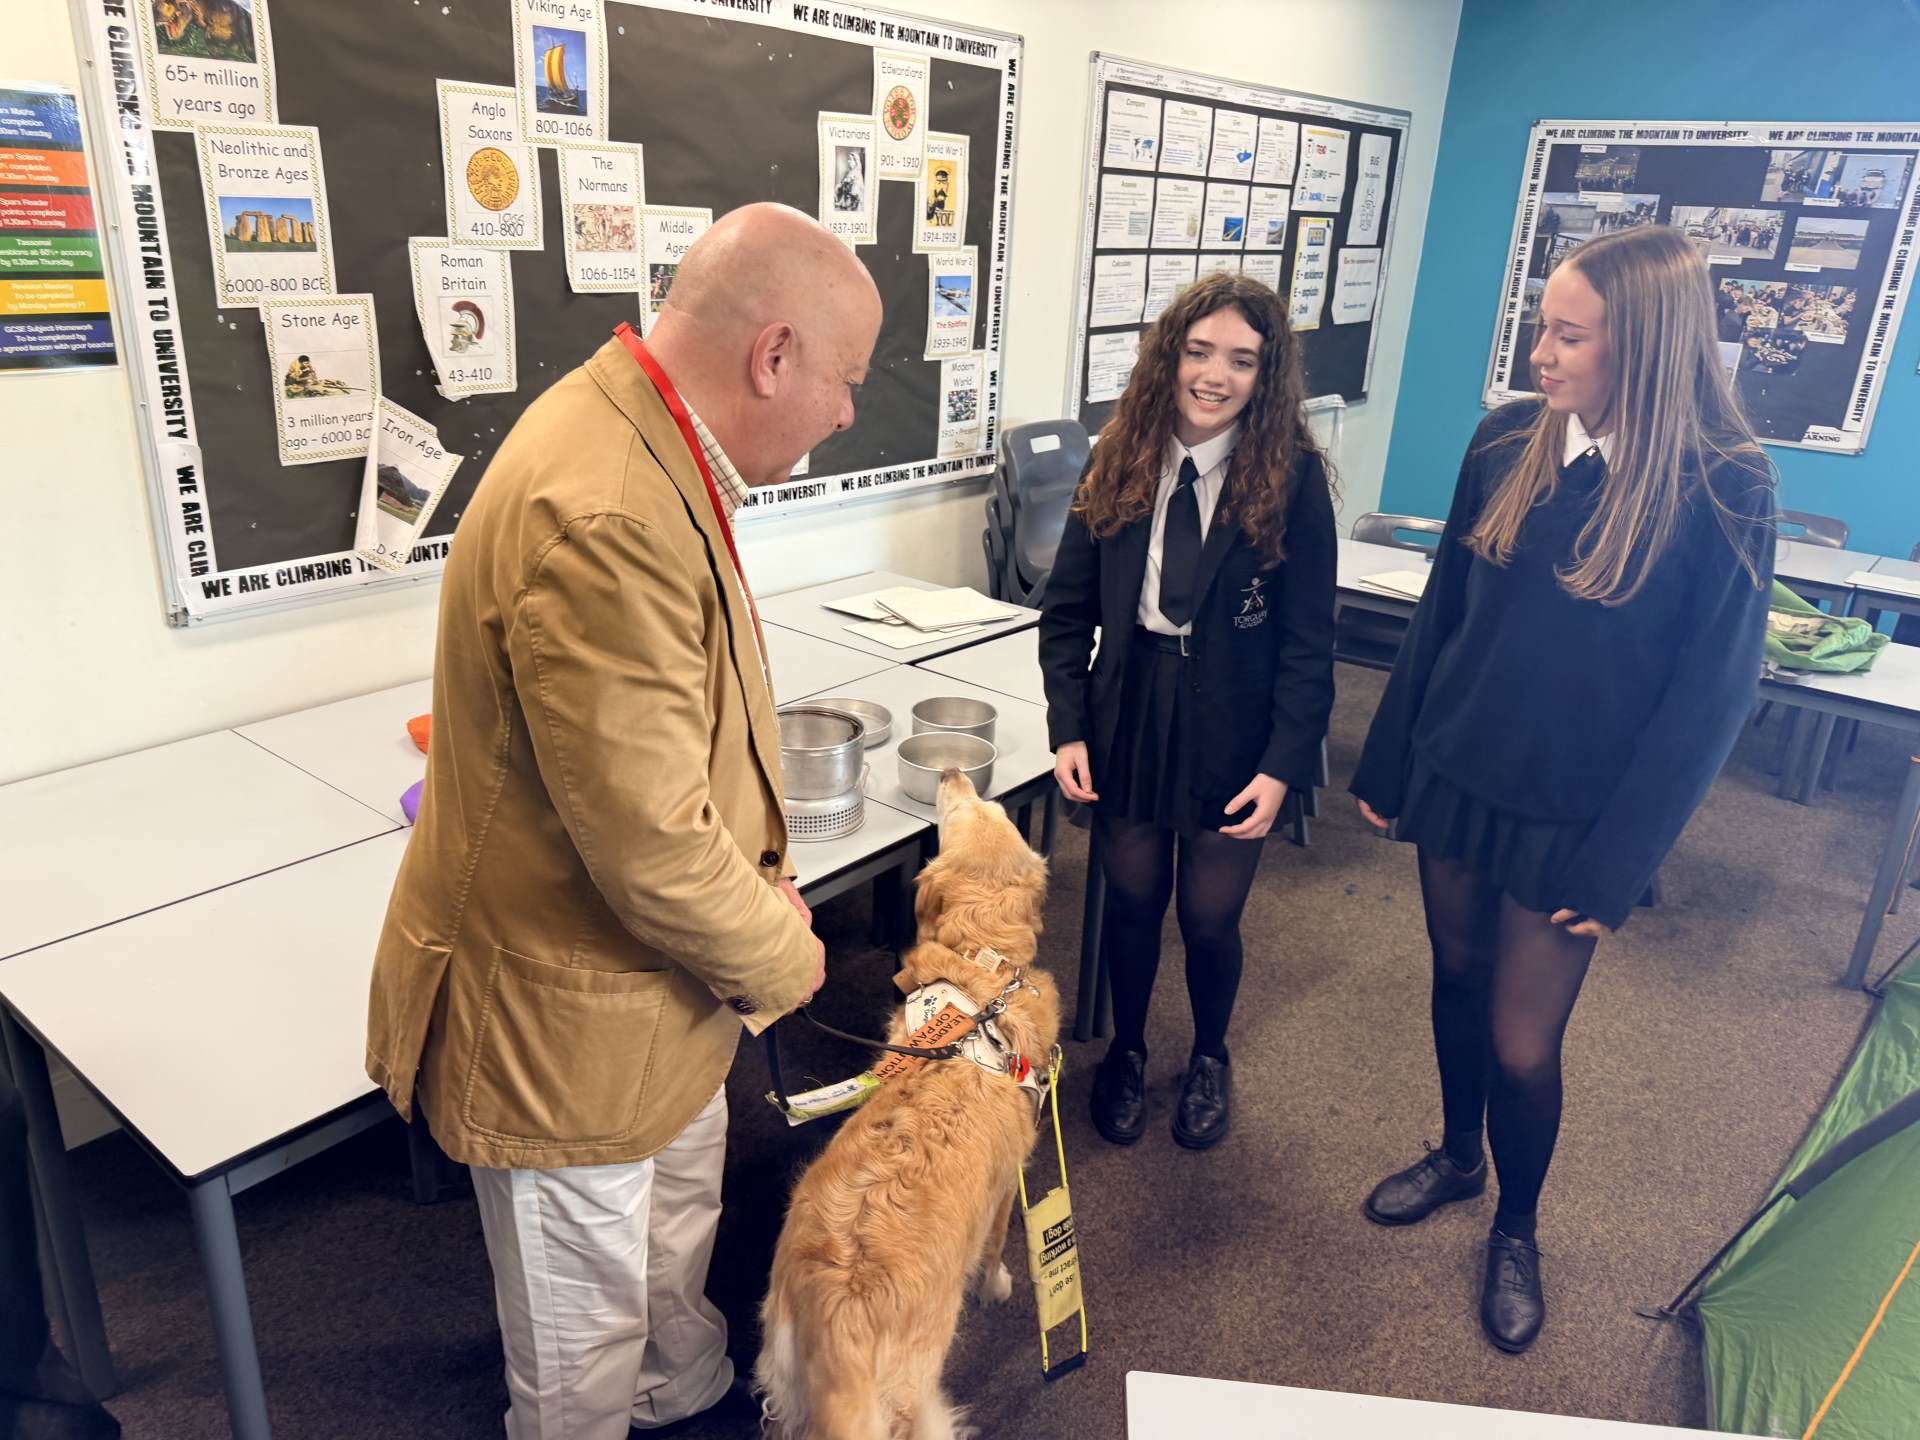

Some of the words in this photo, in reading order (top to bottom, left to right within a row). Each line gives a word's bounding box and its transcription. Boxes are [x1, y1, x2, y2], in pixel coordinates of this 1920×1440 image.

[527, 0, 566, 19] Viking
[569, 3, 593, 22] Age
[793, 3, 809, 22] WE
[812, 8, 830, 27] ARE
[832, 12, 876, 36] CLIMBING
[880, 21, 894, 40] THE
[897, 25, 940, 49] MOUNTAIN
[943, 34, 953, 50] TO
[955, 36, 998, 60] UNIVERSITY
[165, 64, 198, 82] 65+
[204, 68, 260, 89] million
[1008, 58, 1017, 78] WE
[1006, 84, 1016, 106] ARE
[172, 97, 222, 115] years
[227, 102, 256, 119] ago
[471, 101, 507, 121] Anglo
[468, 124, 513, 141] Saxons
[535, 119, 593, 137] 800-1066
[828, 126, 871, 140] Victorians
[1546, 128, 1558, 138] WE
[1560, 129, 1576, 139] ARE
[1578, 129, 1615, 139] CLIMBING
[1619, 129, 1633, 139] THE
[1635, 129, 1680, 140] MOUNTAIN
[1682, 130, 1693, 140] TO
[1696, 130, 1749, 141] UNIVERSITY
[1768, 130, 1783, 141] WE
[1806, 131, 1853, 142] CLIMBING
[1856, 131, 1873, 142] THE
[210, 138, 280, 157] Neolithic
[283, 143, 309, 158] and
[1002, 111, 1014, 170] CLIMBING
[591, 156, 614, 170] The
[1531, 138, 1547, 180] MOUNTAIN
[218, 163, 270, 180] Bronze
[274, 167, 310, 184] Ages
[578, 177, 628, 193] Normans
[1000, 175, 1009, 196] THE
[1528, 183, 1538, 198] THE
[659, 221, 694, 234] Middle
[935, 211, 954, 226] YOU
[1519, 199, 1535, 244] UNIVERSITY
[131, 184, 167, 290] MOUNTAIN
[996, 200, 1007, 262] MOUNTAIN
[1900, 229, 1914, 246] ARE
[440, 253, 484, 268] Roman
[1517, 246, 1527, 258] TO
[580, 267, 636, 281] 1066-1154
[995, 266, 1003, 282] TO
[1510, 259, 1525, 298] MOUNTAIN
[1888, 249, 1909, 291] CLIMBING
[225, 277, 298, 293] 6000-800
[302, 277, 326, 292] BCE
[442, 276, 487, 290] Britain
[148, 296, 170, 322] TO
[1507, 299, 1517, 314] THE
[1883, 294, 1897, 310] THE
[281, 313, 327, 328] Stone
[331, 312, 360, 330] Age
[990, 286, 1003, 352] UNIVERSITY
[4, 326, 27, 334] GCSE
[27, 325, 55, 335] Subject
[55, 324, 94, 333] Homework
[16, 335, 26, 343] To
[27, 335, 37, 343] be
[38, 334, 76, 344] completed
[1501, 317, 1514, 352] CLIMBING
[1869, 312, 1891, 357] MOUNTAIN
[1498, 348, 1508, 369] ARE
[1865, 360, 1878, 371] TO
[152, 328, 188, 440] UNIVERSITY
[448, 367, 493, 382] 43-410
[989, 370, 997, 387] WE
[1496, 367, 1505, 383] WE
[988, 392, 996, 411] ARE
[1851, 373, 1873, 423] UNIVERSITY
[287, 415, 296, 429] 3
[299, 413, 339, 428] million
[341, 411, 374, 427] years
[286, 436, 308, 451] ago
[321, 430, 351, 445] 6000
[381, 418, 415, 445] Iron
[415, 439, 443, 461] Age
[176, 465, 198, 495] WE
[841, 477, 855, 491] WE
[858, 474, 872, 488] ARE
[874, 468, 911, 487] CLIMBING
[913, 466, 925, 478] THE
[928, 460, 963, 477] MOUNTAIN
[965, 457, 974, 469] TO
[762, 490, 774, 505] TO
[777, 482, 827, 504] UNIVERSITY
[181, 502, 204, 536] ARE
[201, 577, 232, 599] WE
[238, 573, 271, 594] ARE
[276, 557, 353, 588] CLIMBING
[927, 1014, 966, 1045] LEADER
[1040, 1242, 1067, 1263] working
[1048, 1266, 1059, 1278] me
